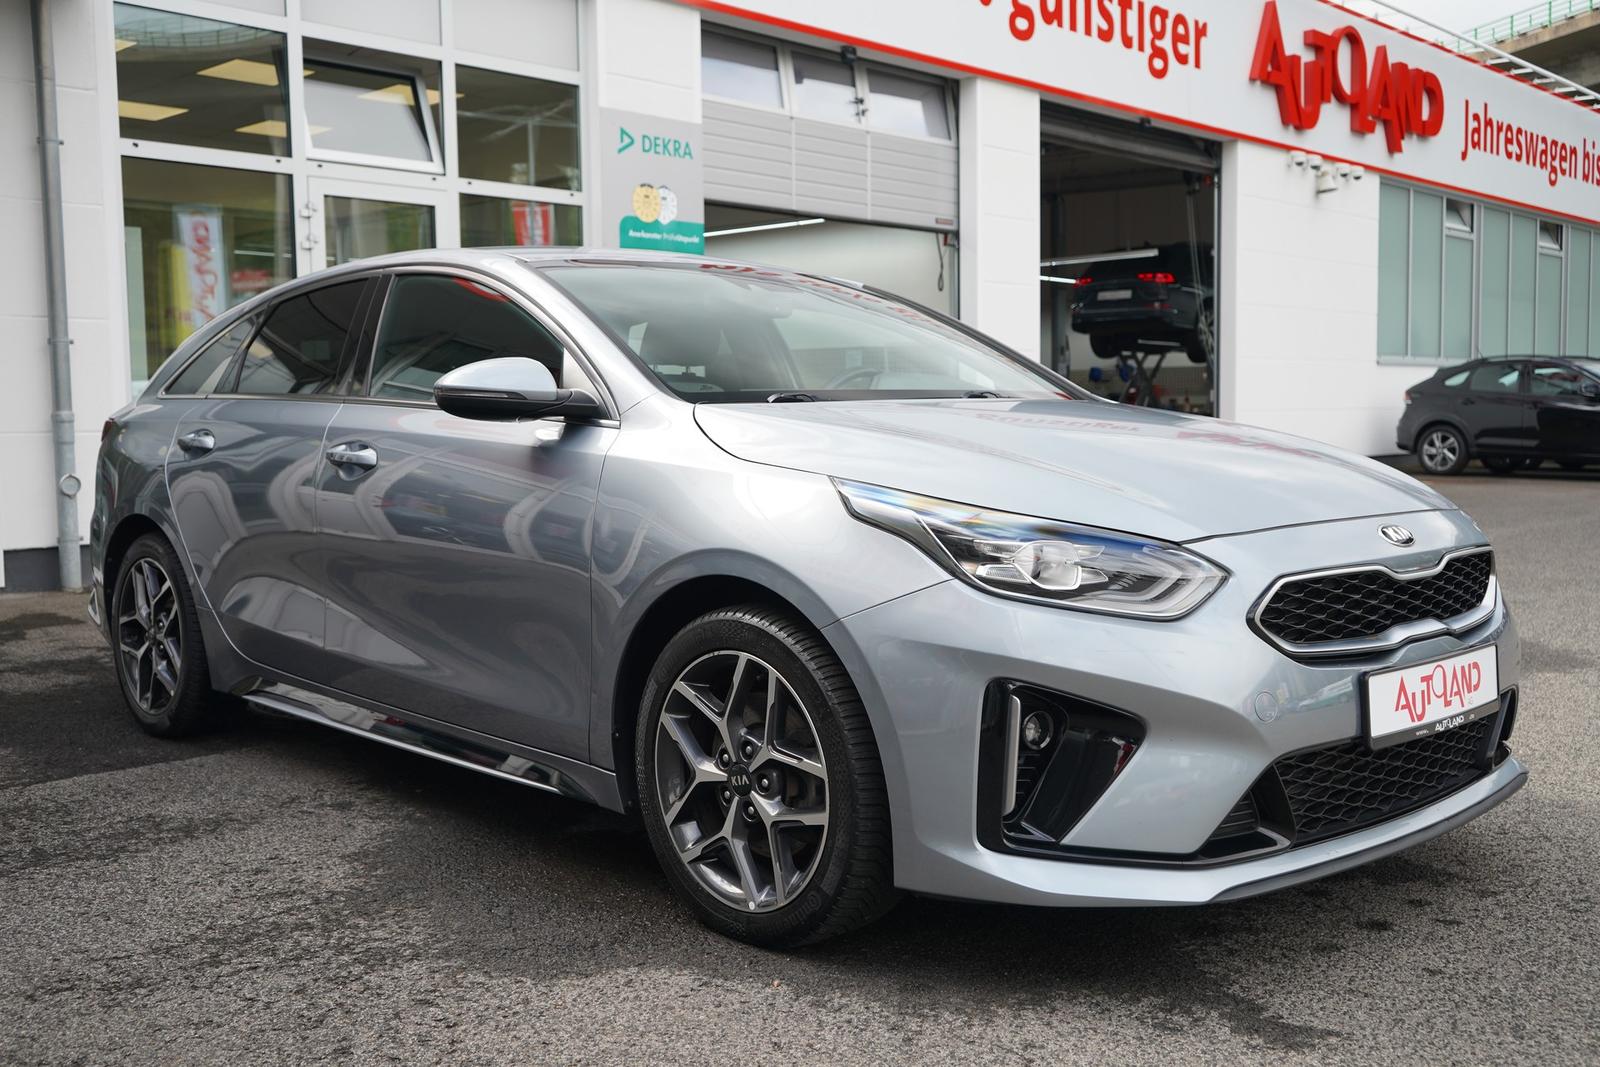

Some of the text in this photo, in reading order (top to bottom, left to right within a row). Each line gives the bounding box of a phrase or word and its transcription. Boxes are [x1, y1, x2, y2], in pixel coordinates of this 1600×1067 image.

[1249, 0, 1445, 154] AUTOLAND
[641, 134, 693, 160] DEKRA
[1461, 99, 1578, 187] Jahreswagen
[1394, 661, 1482, 723] AUTOLAND
[1434, 715, 1465, 732] AUTOLAND
[731, 775, 750, 786] KIA
